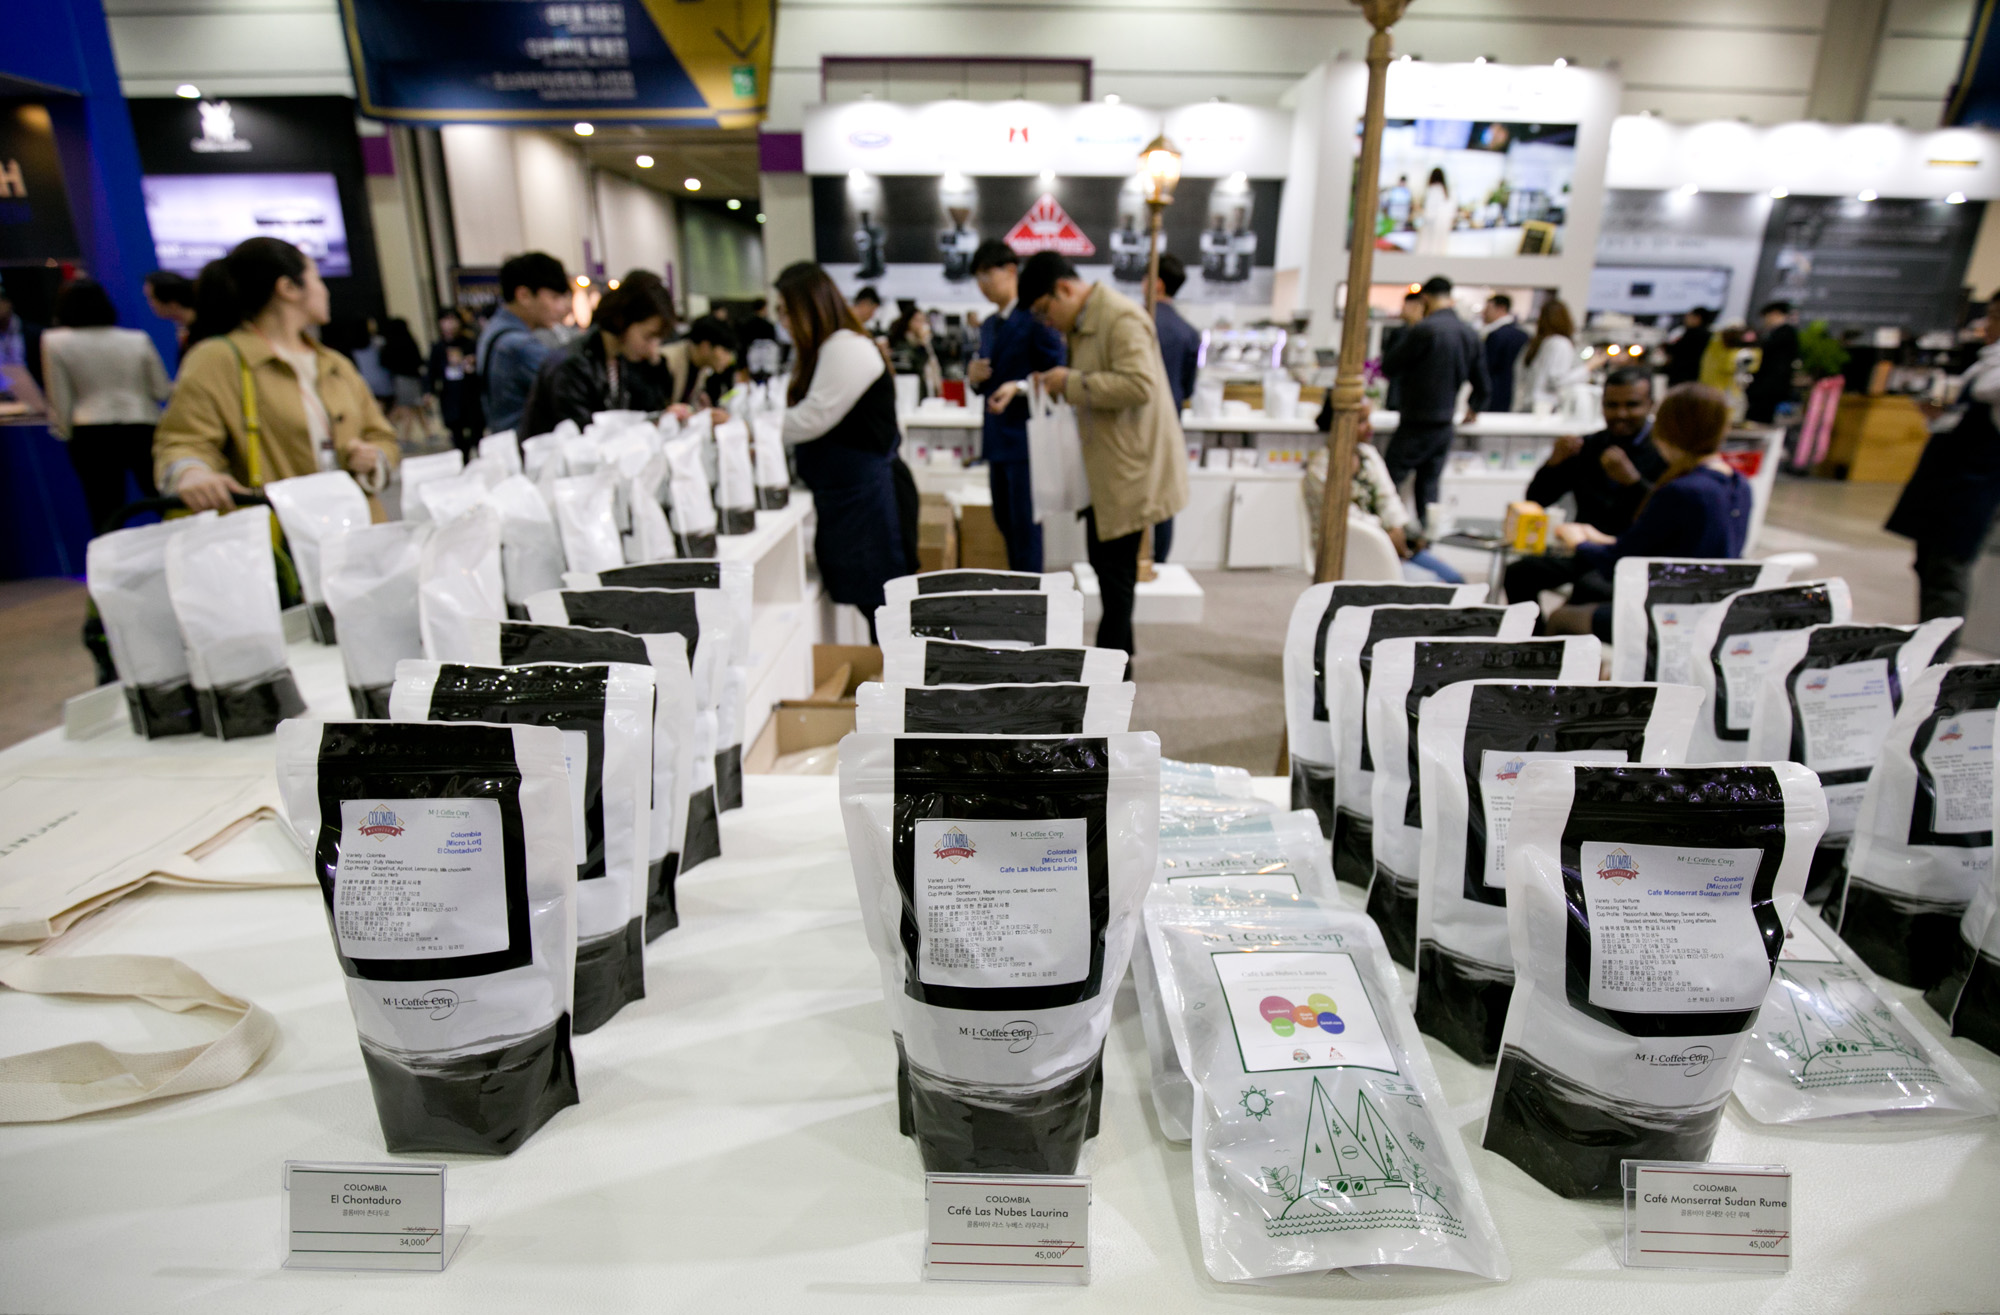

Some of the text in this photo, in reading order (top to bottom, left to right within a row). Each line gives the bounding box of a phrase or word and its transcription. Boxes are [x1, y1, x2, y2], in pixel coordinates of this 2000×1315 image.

[368, 811, 396, 826] COLOMBIA
[943, 833, 968, 848] COLOMBIA
[1064, 856, 1077, 864] Lot]
[1606, 854, 1632, 870] COLOMBIA
[1706, 882, 1728, 890] [Micro
[1693, 1184, 1737, 1192] COLOMBIA
[331, 1195, 401, 1205] El Chontaduro
[985, 1196, 1030, 1204] COLOMBIA
[1644, 1194, 1787, 1208] Café Monserrat Sudan Rume
[947, 1205, 1068, 1218] Café Las Nubes Laurina
[1724, 1210, 1736, 1218] 수단
[1738, 1211, 1750, 1219] 루메
[1005, 1221, 1023, 1229] 누베스
[400, 1238, 426, 1247] 34,000
[1749, 1241, 1775, 1249] 45,000
[1035, 1251, 1061, 1260] 45,000
